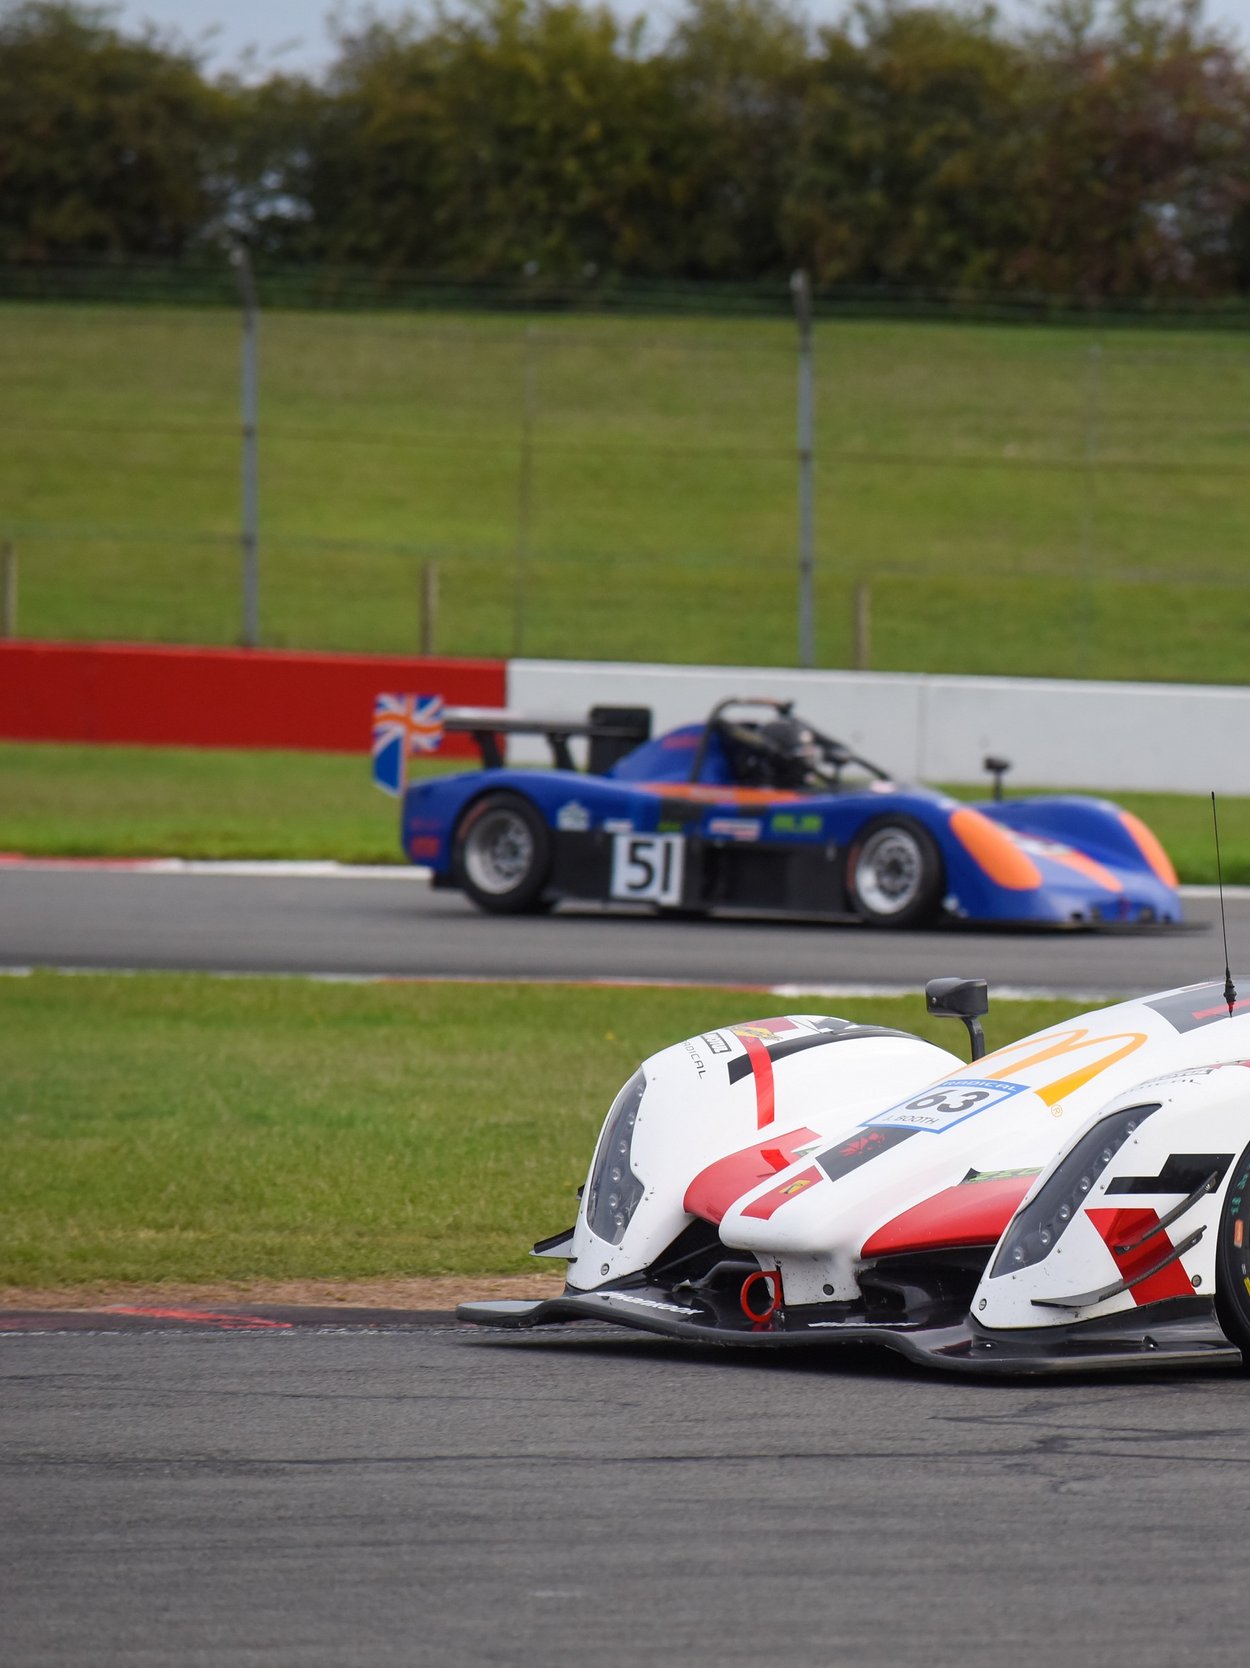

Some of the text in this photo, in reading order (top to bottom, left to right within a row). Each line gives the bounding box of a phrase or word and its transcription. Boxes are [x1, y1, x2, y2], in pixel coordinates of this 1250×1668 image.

[627, 841, 672, 893] 51
[943, 1080, 1018, 1092] RADICAL
[905, 1089, 990, 1113] 63
